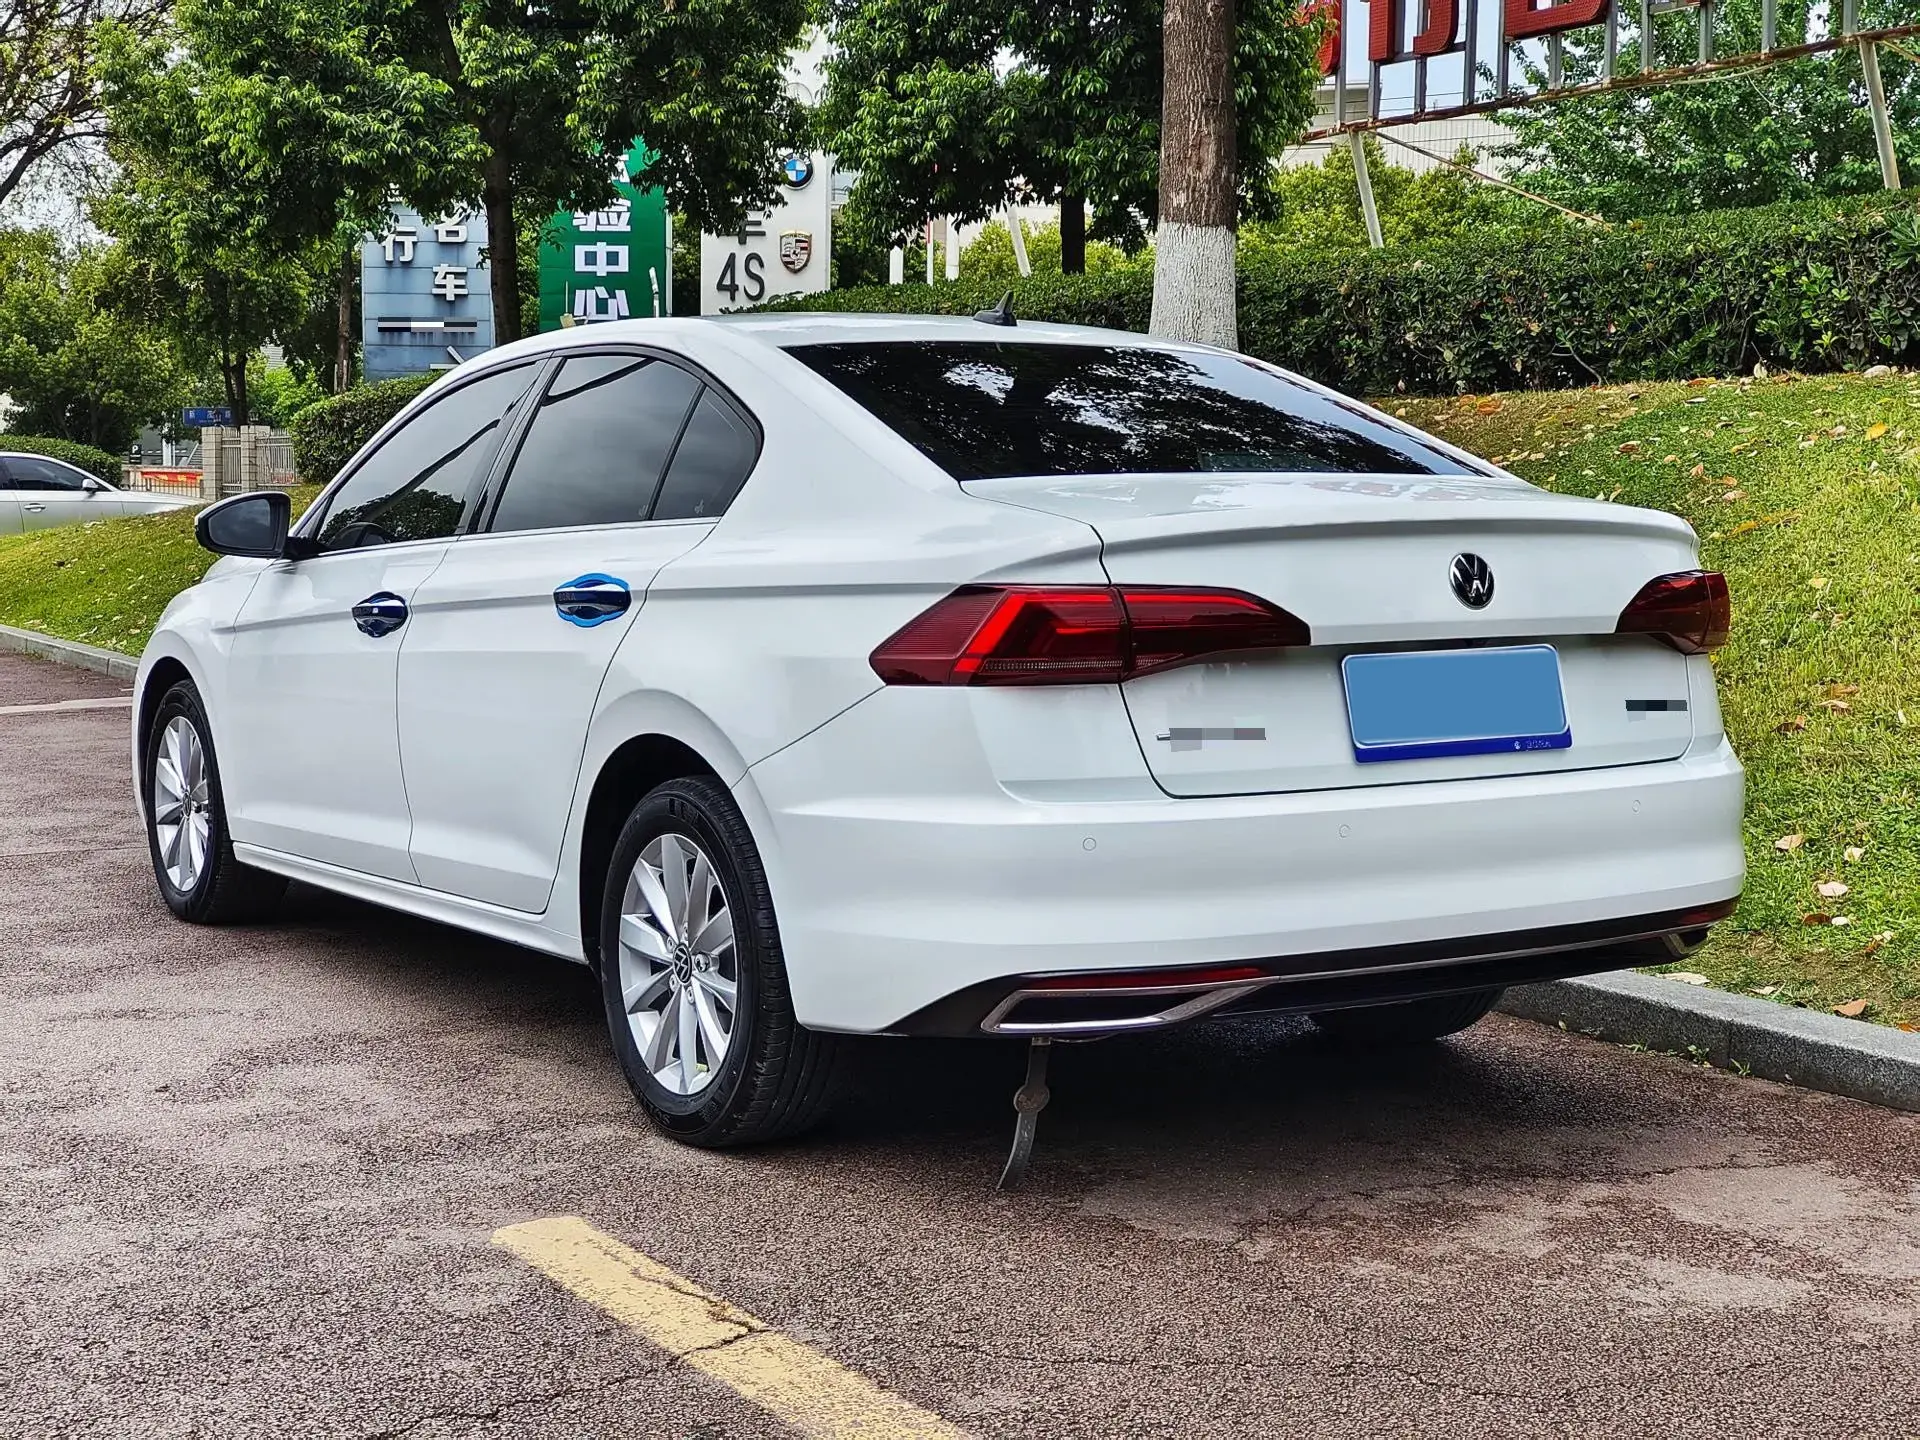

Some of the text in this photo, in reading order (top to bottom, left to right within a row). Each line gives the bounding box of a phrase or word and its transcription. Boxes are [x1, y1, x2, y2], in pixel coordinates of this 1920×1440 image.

[573, 154, 632, 320] 验中心
[716, 252, 766, 302] 4S
